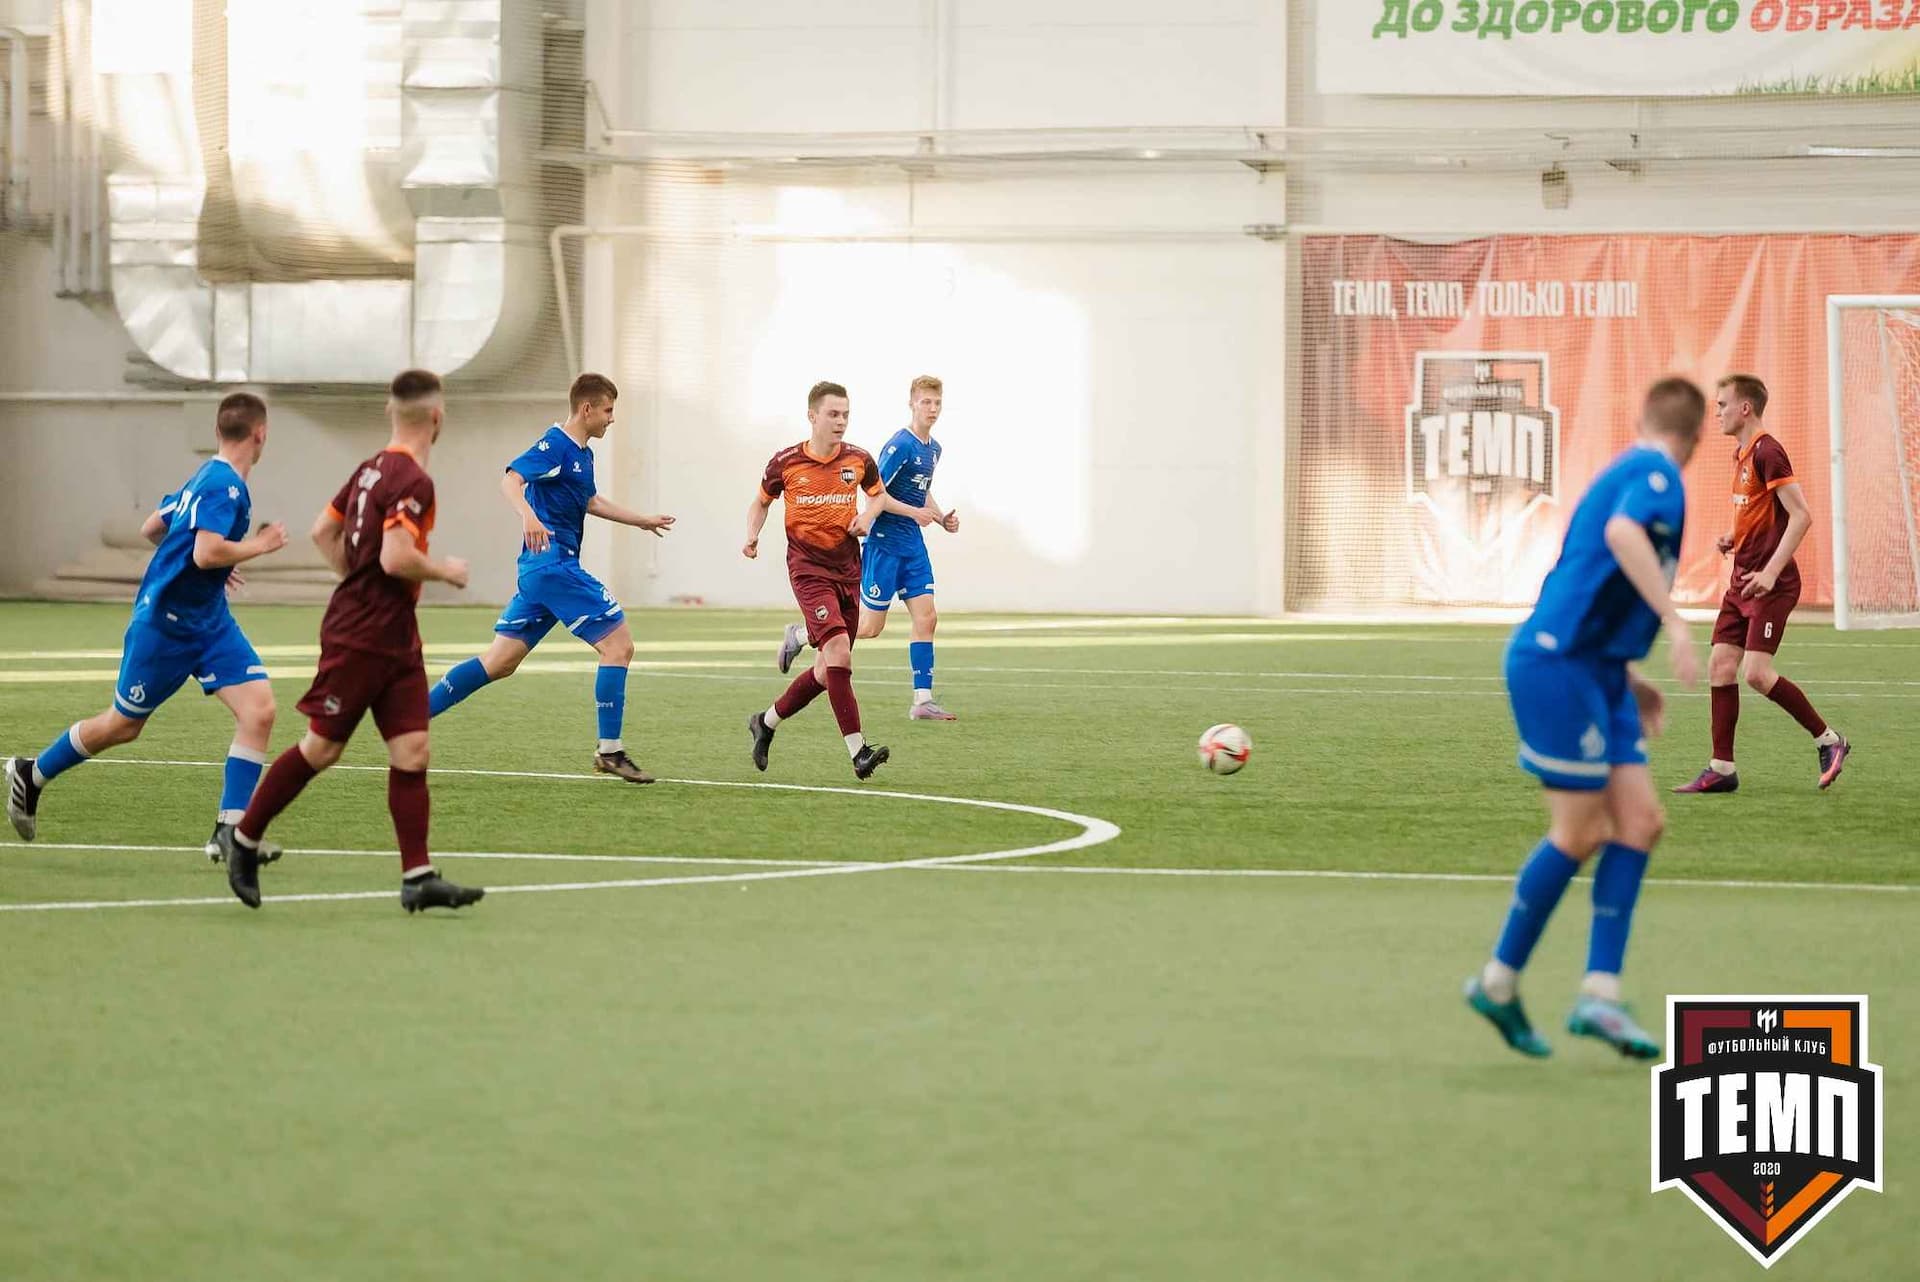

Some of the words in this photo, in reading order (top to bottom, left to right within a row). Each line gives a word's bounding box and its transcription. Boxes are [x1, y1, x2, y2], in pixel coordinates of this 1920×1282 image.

[1372, 0, 1444, 38] ДО
[1451, 0, 1740, 39] ЗДОРОВОГО
[1333, 280, 1397, 320] ТЕМП,
[1404, 280, 1471, 320] ТЕМП,
[1476, 280, 1564, 317] ТОЛЬКО
[1570, 280, 1639, 318] ТЕМП!
[1420, 411, 1544, 482] ТЕМП
[1764, 621, 1773, 639] 6
